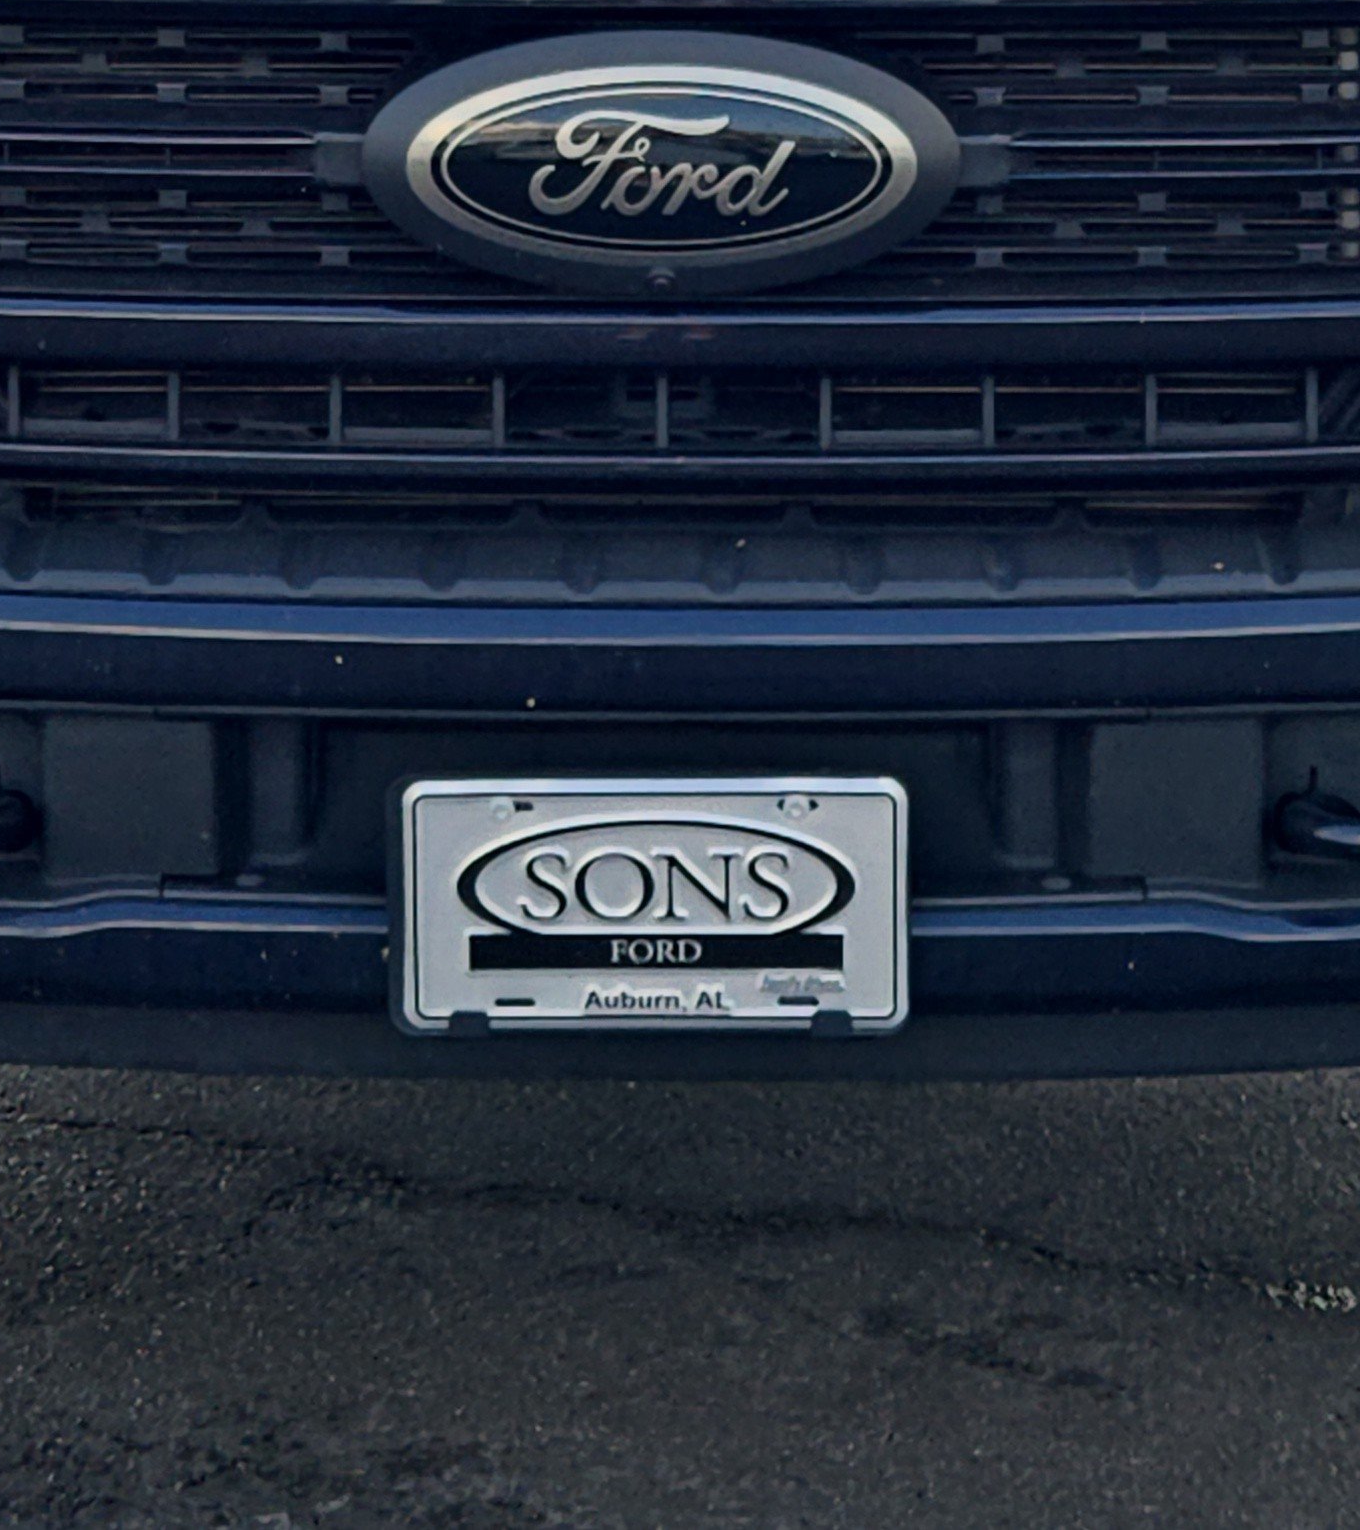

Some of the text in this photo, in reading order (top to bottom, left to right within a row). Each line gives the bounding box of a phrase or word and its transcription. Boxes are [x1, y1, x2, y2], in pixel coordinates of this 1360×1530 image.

[529, 110, 796, 216] Ford
[516, 845, 792, 922] SONS
[610, 937, 703, 964] FORD
[583, 990, 731, 1013] Auburn, AL
